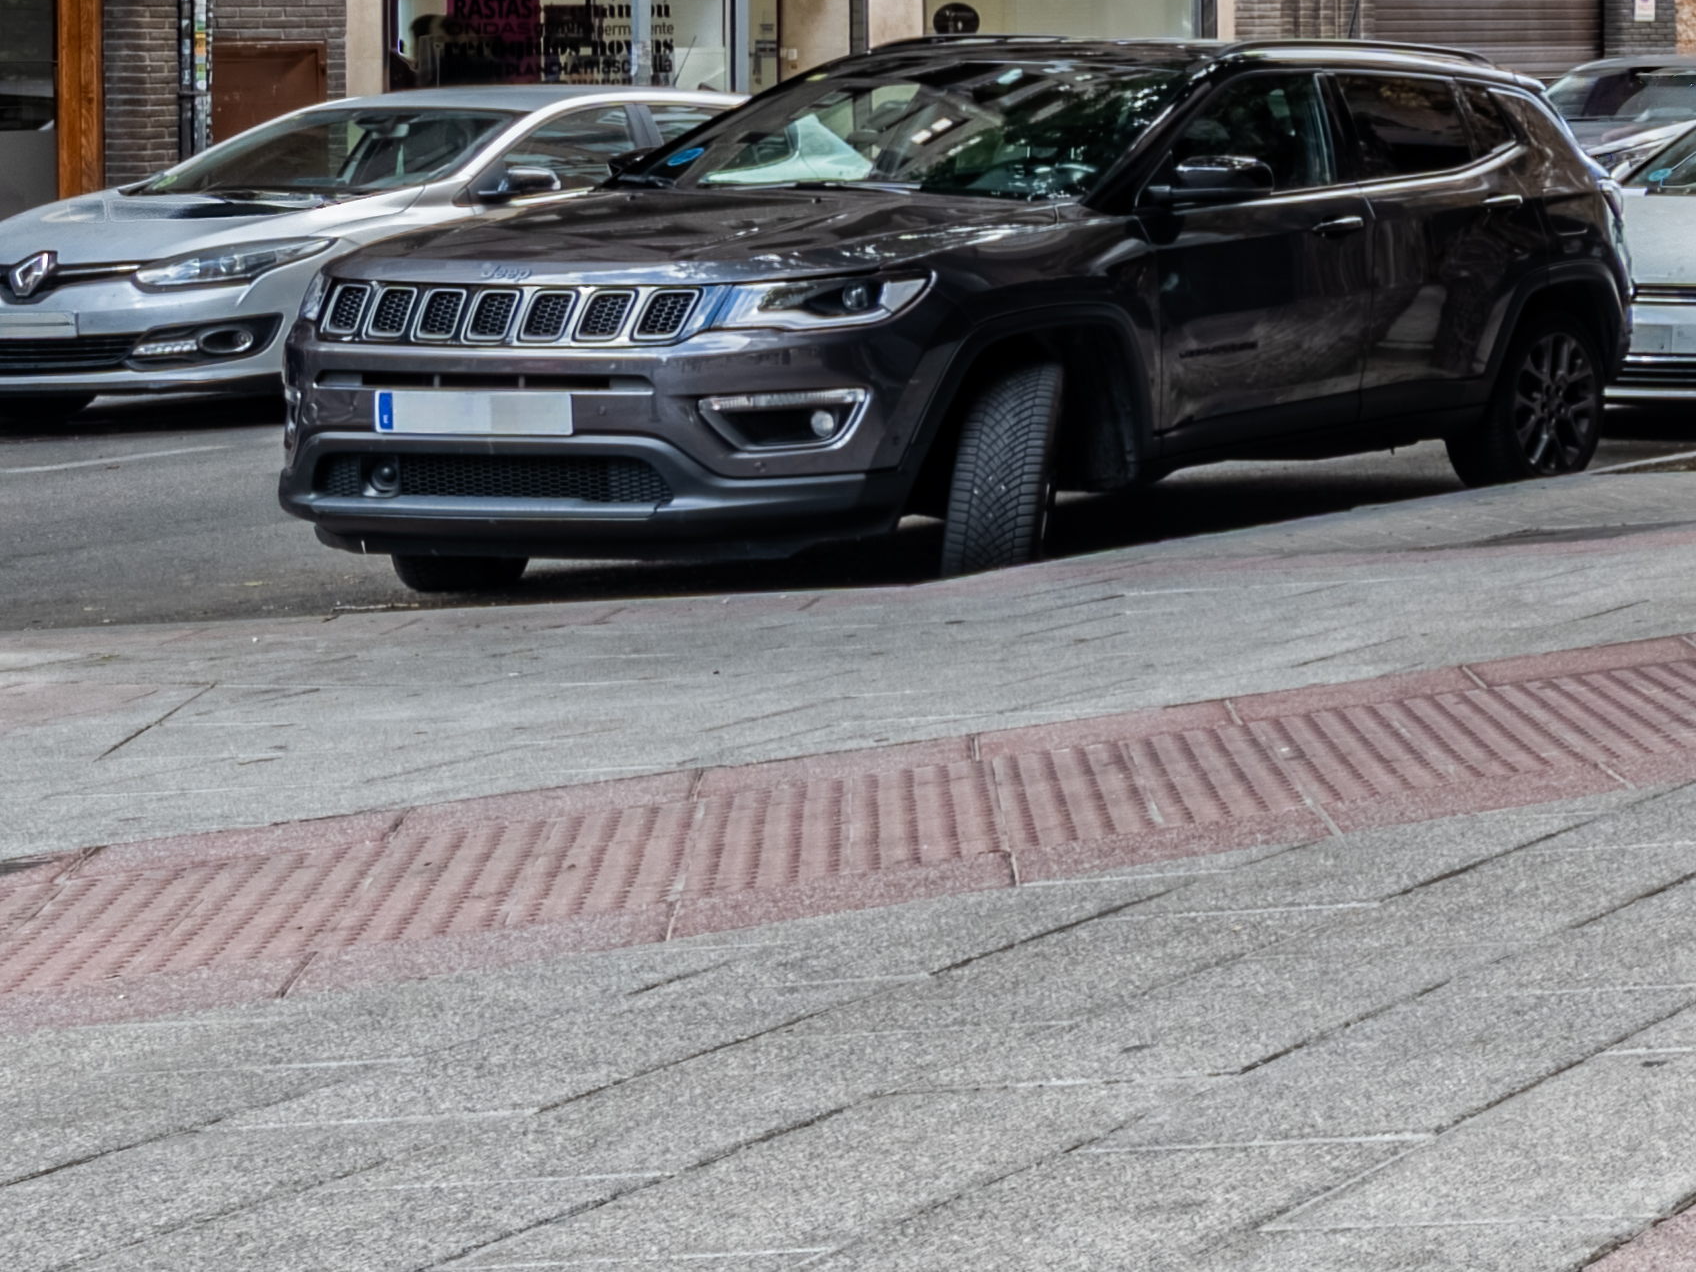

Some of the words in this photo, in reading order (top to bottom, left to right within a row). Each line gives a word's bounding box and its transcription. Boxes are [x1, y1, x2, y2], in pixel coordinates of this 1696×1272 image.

[446, 22, 531, 35] ONDAS
[597, 23, 675, 37] permente
[584, 58, 674, 74] masclla
[480, 264, 533, 283] Jeep
